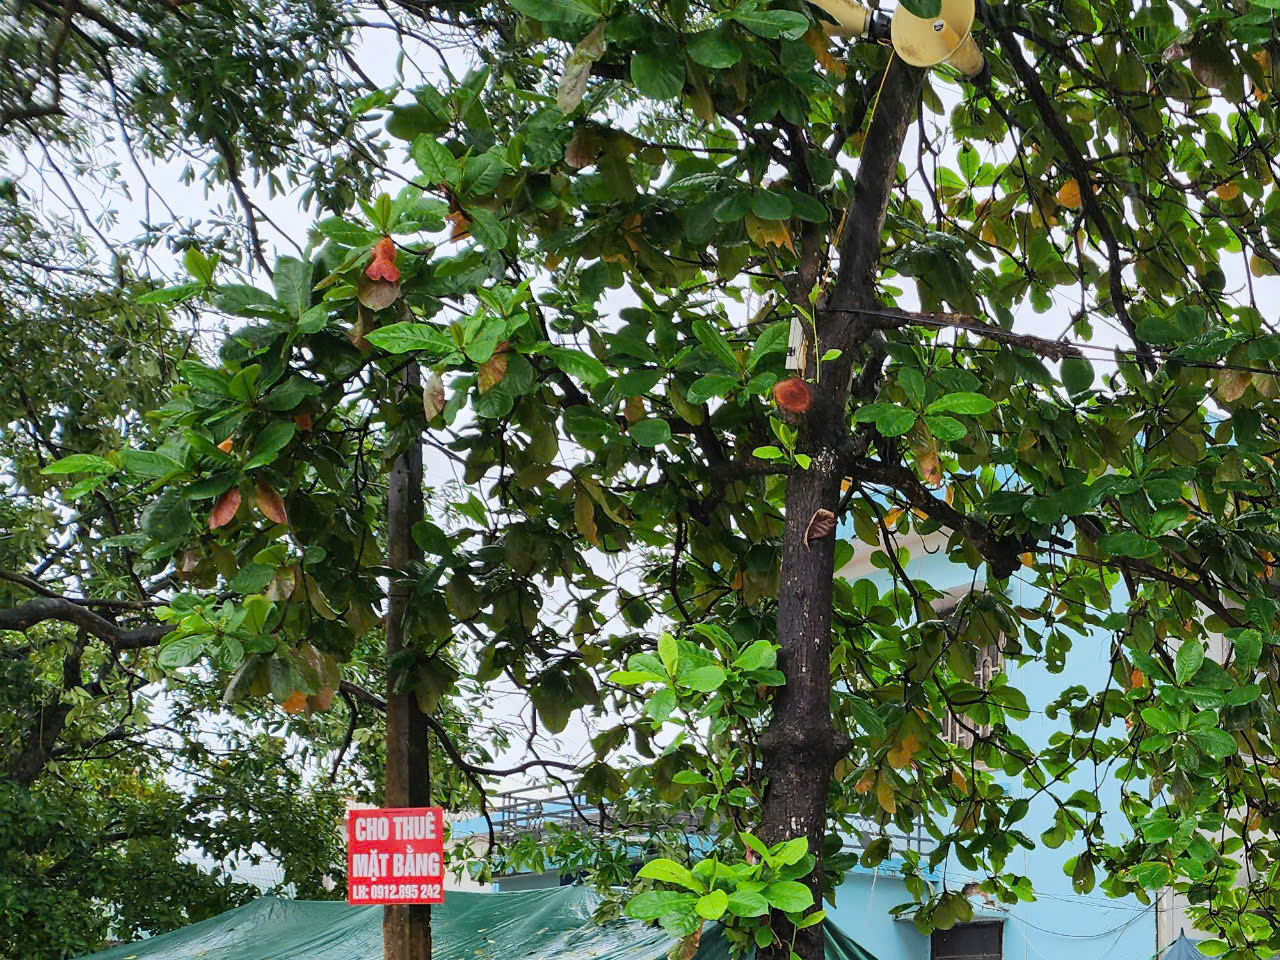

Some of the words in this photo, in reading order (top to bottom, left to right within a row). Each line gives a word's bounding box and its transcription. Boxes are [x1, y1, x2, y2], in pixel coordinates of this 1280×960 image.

[355, 816, 389, 841] CHO
[393, 811, 436, 840] THUÊ
[352, 849, 389, 881] MẶT
[392, 844, 440, 877] BẰNG
[420, 884, 440, 899] 242
